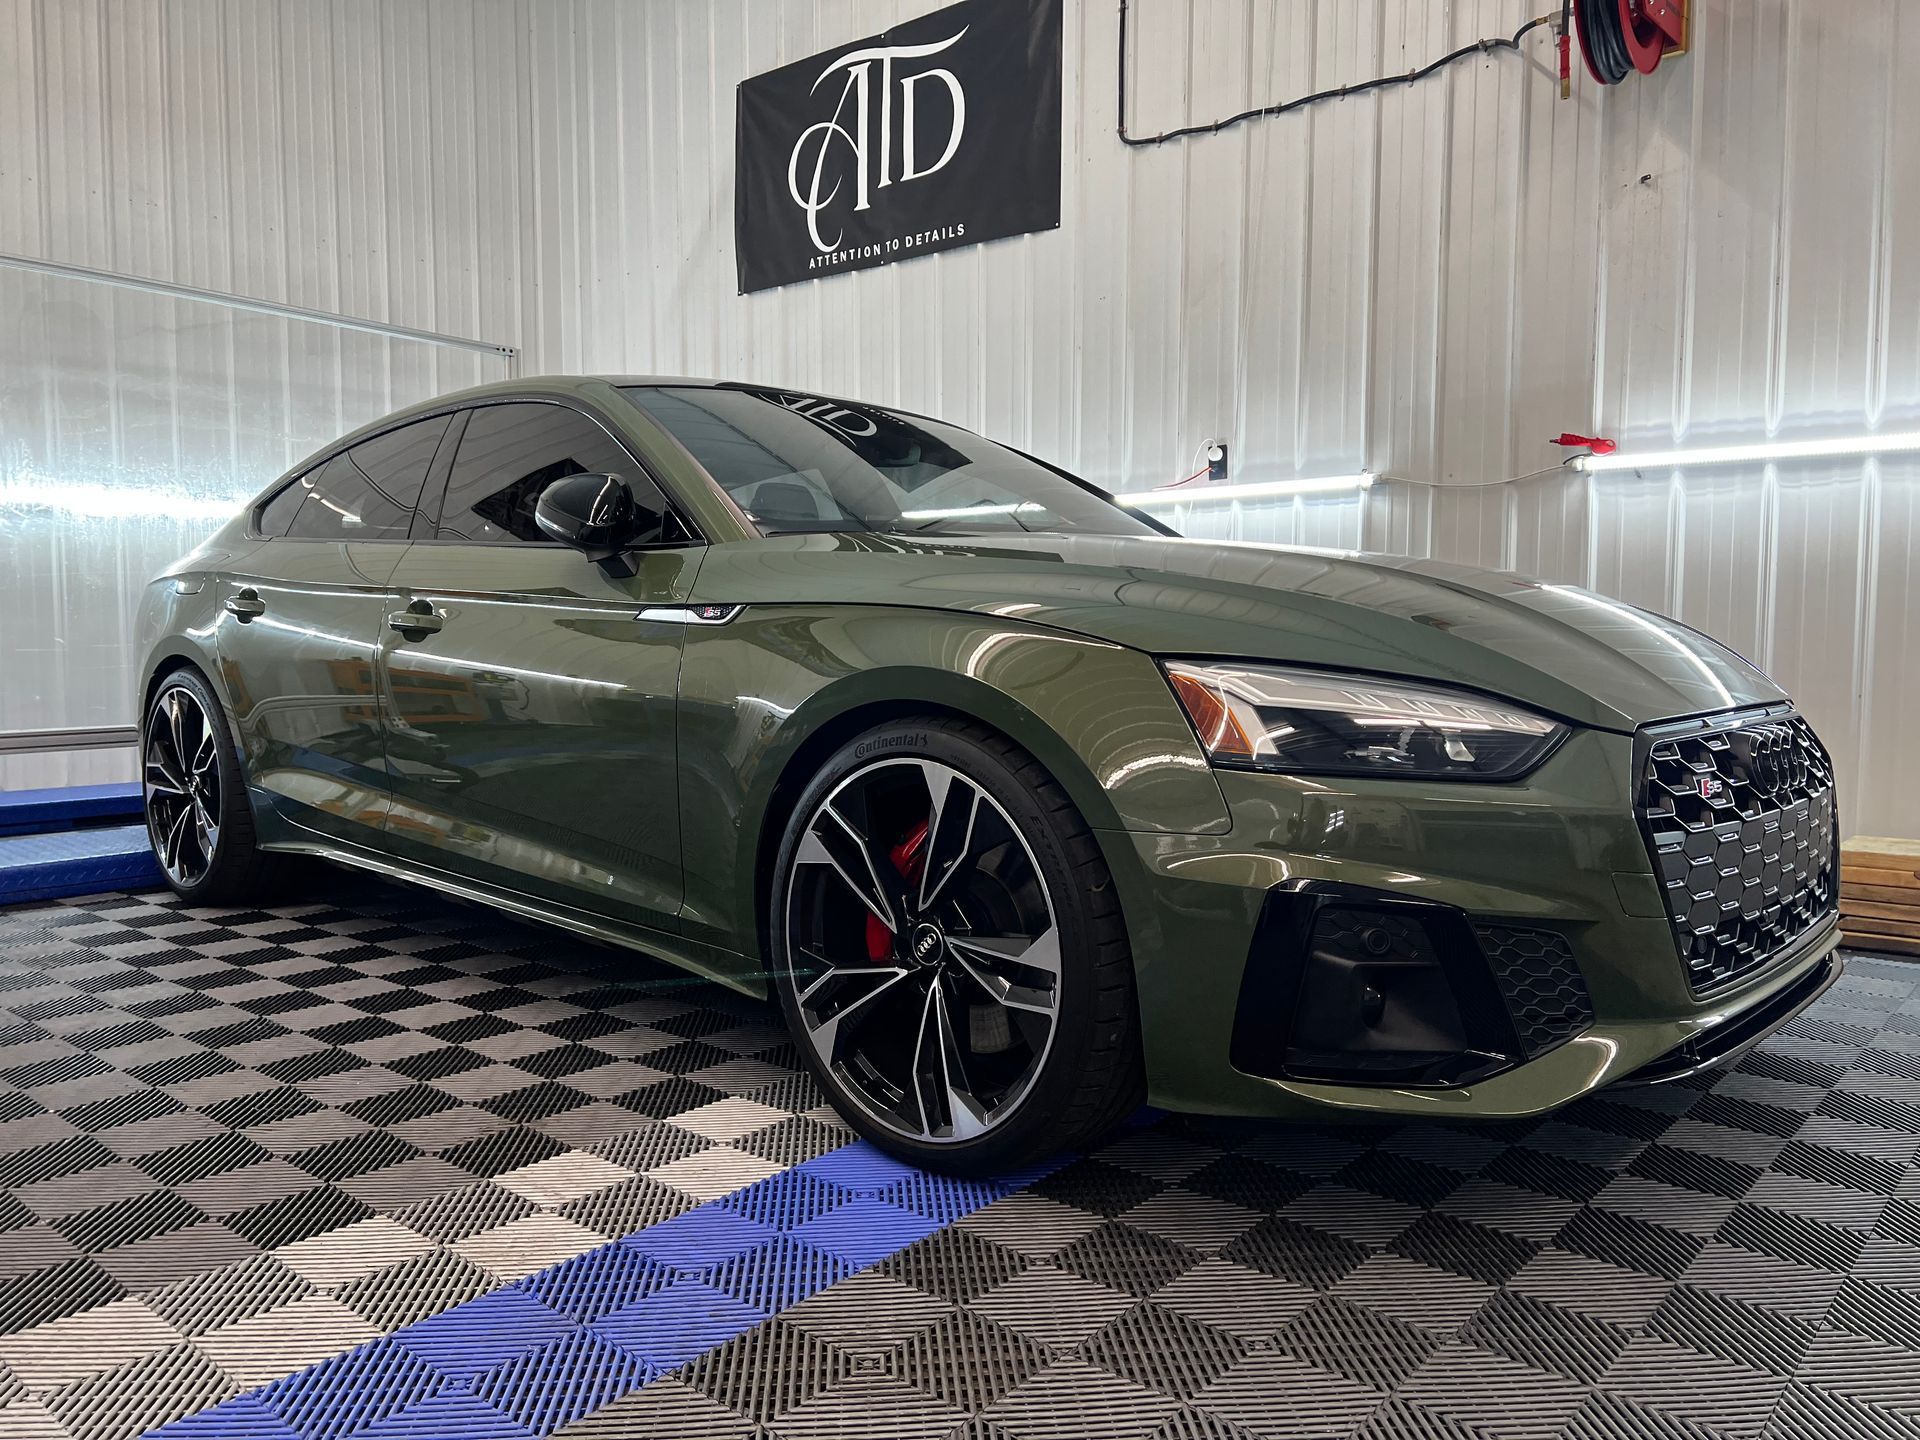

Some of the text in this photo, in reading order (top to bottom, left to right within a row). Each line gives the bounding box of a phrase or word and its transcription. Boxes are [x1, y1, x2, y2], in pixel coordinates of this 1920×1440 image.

[787, 24, 970, 253] ATD
[808, 223, 966, 269] ATTENTION TO DETAILS
[854, 733, 920, 759] Continental
[1703, 779, 1723, 796] S5
